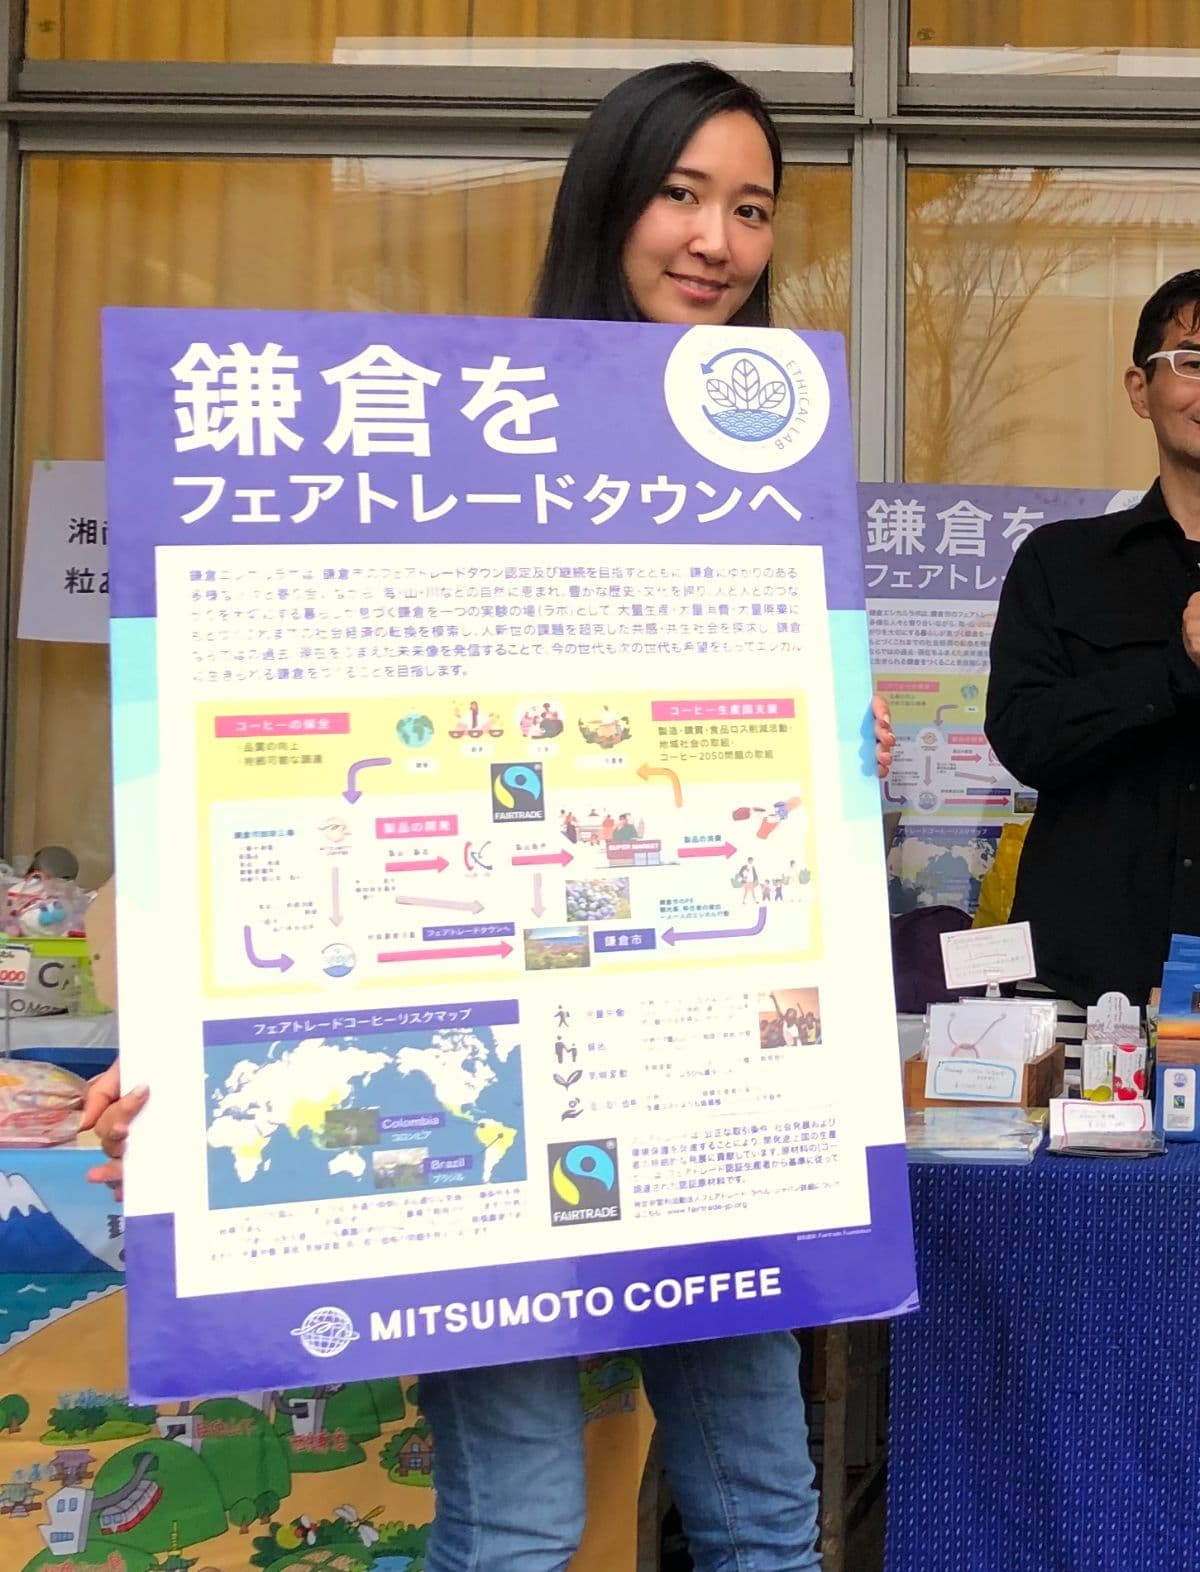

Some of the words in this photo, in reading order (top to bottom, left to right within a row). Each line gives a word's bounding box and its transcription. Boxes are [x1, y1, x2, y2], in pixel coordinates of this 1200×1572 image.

[171, 341, 560, 458] 鎌倉を
[785, 359, 810, 424] ETHICAL
[774, 427, 801, 450] LAB
[172, 473, 804, 525] フェアトレードタウンへ
[866, 498, 1044, 557] 鎌倉を
[865, 564, 1005, 590] フェアトレ
[494, 810, 544, 821] FAIRTRADE
[604, 934, 643, 947] 鎌倉市
[253, 1008, 472, 1035] フェアトレードコーヒーリスクマップ
[382, 1116, 440, 1130] Colombia
[430, 1157, 465, 1171] Brazil
[553, 1205, 618, 1223] FAIRTRADE
[370, 1285, 612, 1341] MITSUMOTO
[624, 1266, 782, 1308] COFFEE
